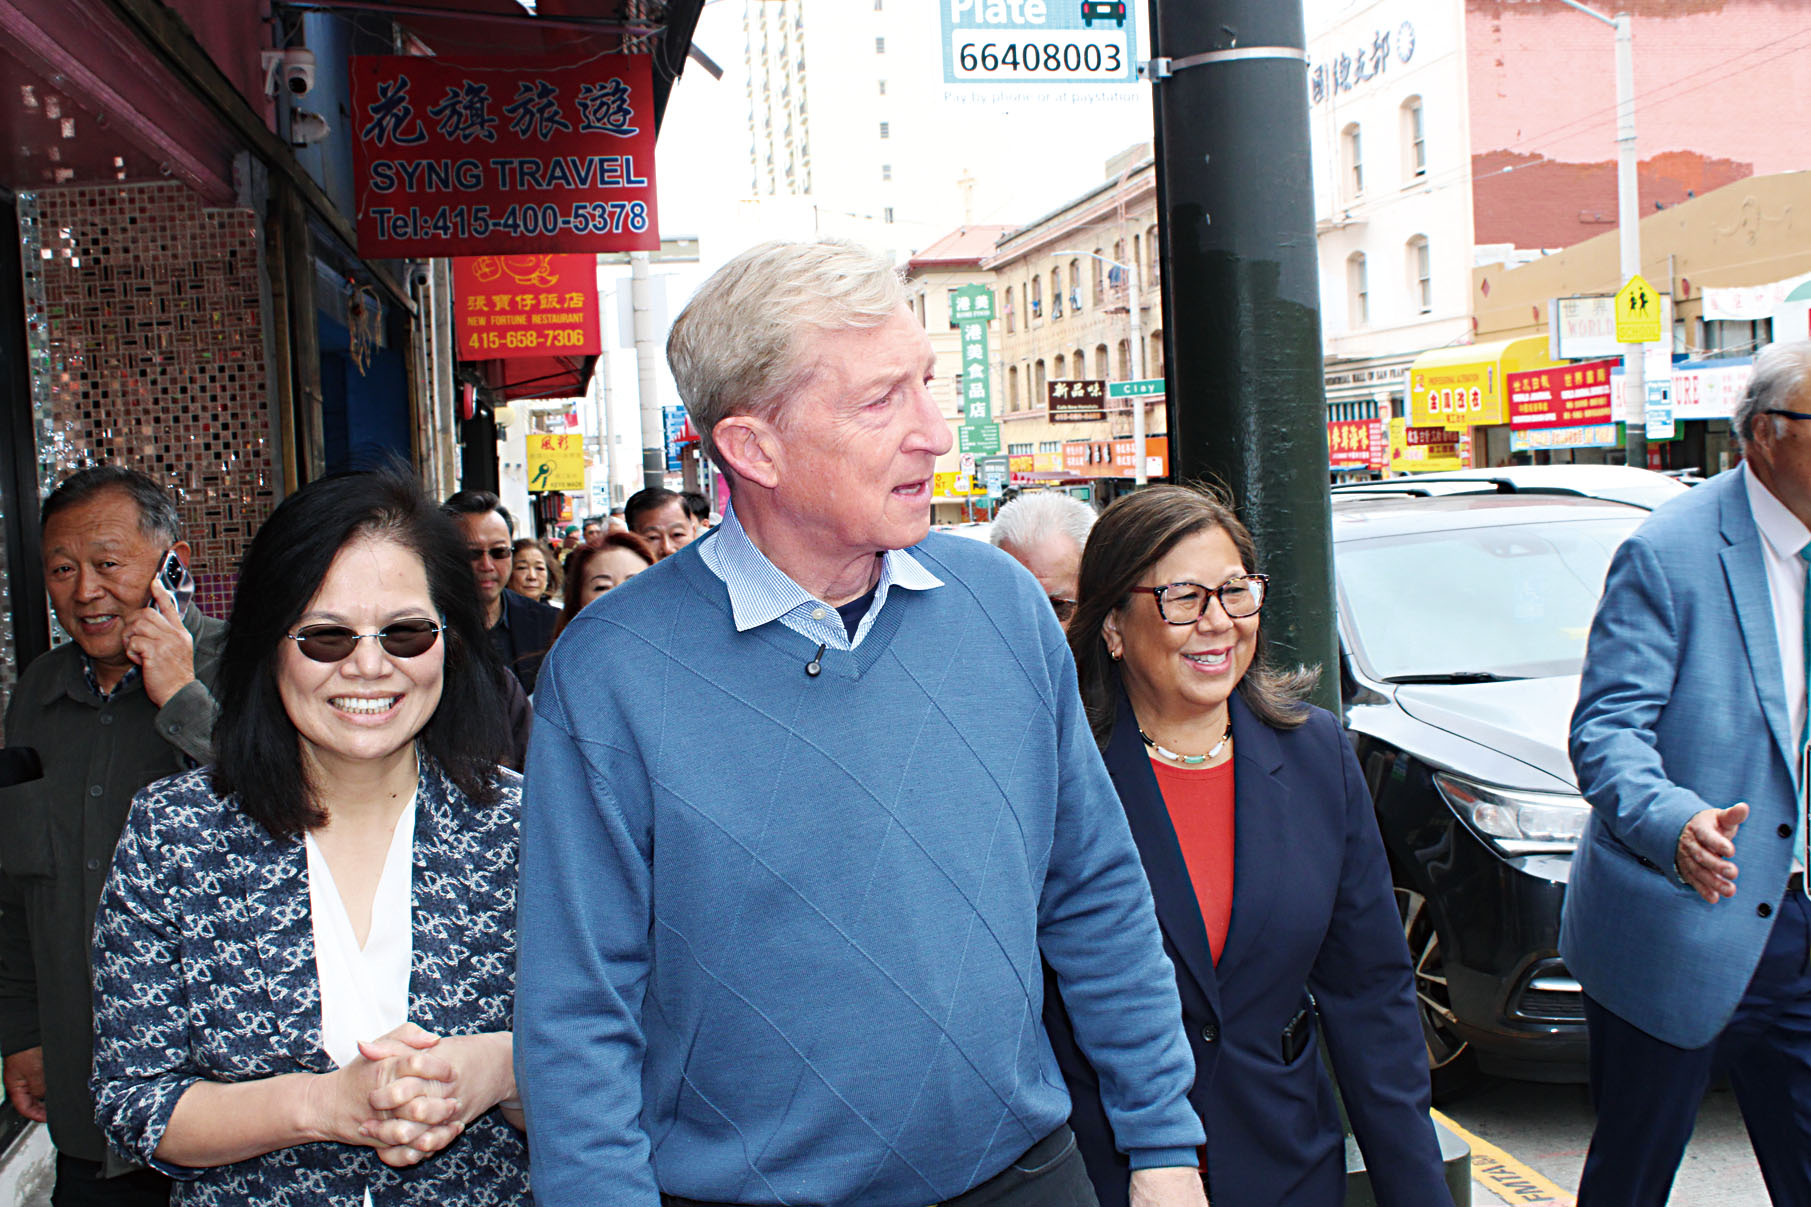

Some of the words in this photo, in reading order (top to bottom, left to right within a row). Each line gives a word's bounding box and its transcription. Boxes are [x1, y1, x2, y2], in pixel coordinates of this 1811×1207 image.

[951, 0, 1047, 24] Plate
[960, 43, 1121, 71] 66408003
[362, 75, 640, 147] 花旗旅遊
[370, 160, 483, 193] SYNG
[491, 156, 648, 190] TRAVEL
[370, 201, 648, 240] Tel:415-400-5378
[467, 292, 585, 311] 張寶仔飯店
[467, 316, 486, 326] NEW
[490, 314, 527, 325] FORTUNE
[532, 313, 584, 324] RESTAURANT
[469, 330, 584, 349] 415-658-7306
[964, 323, 986, 419] 港美食品店
[1053, 382, 1102, 399] 新品味
[1123, 383, 1156, 394] Clay
